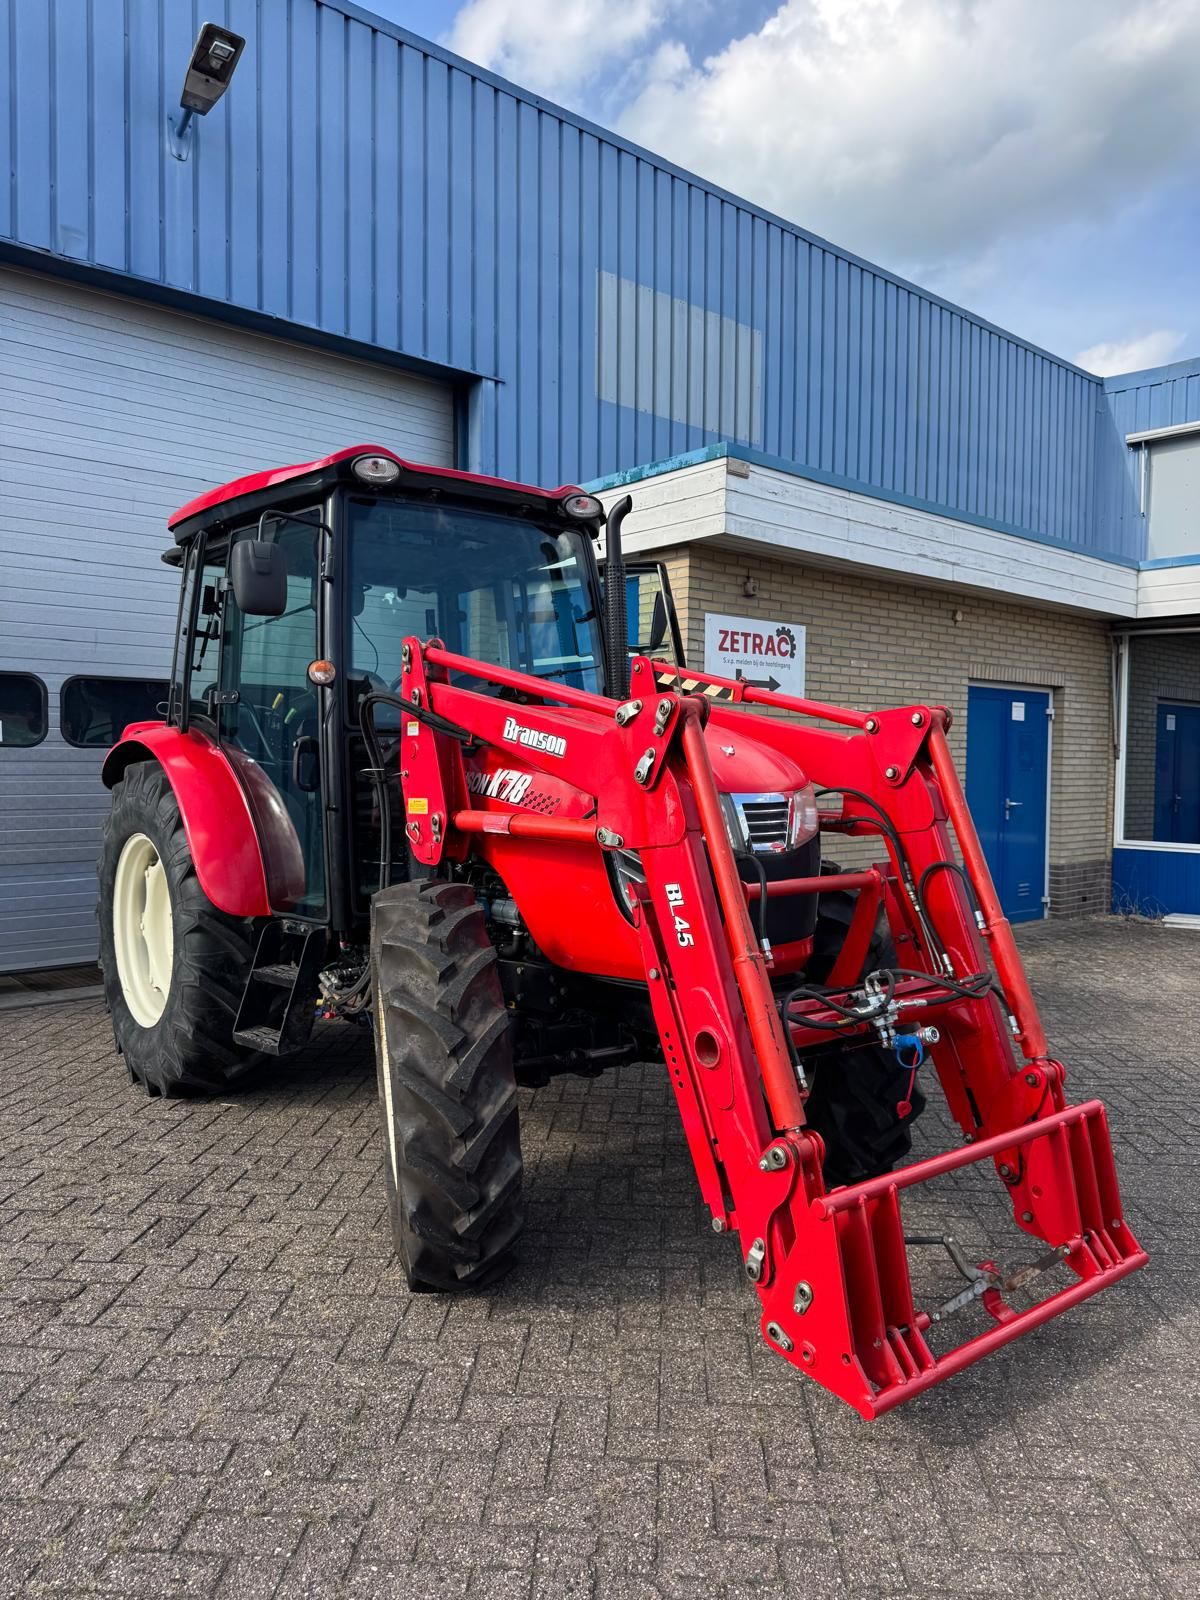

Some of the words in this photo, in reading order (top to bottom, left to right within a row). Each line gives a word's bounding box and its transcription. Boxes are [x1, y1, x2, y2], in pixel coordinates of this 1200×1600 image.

[718, 630, 790, 657] ZETRAC
[735, 658, 752, 666] melden
[503, 717, 567, 759] Branson
[466, 771, 491, 795] SON
[486, 768, 532, 804] K78
